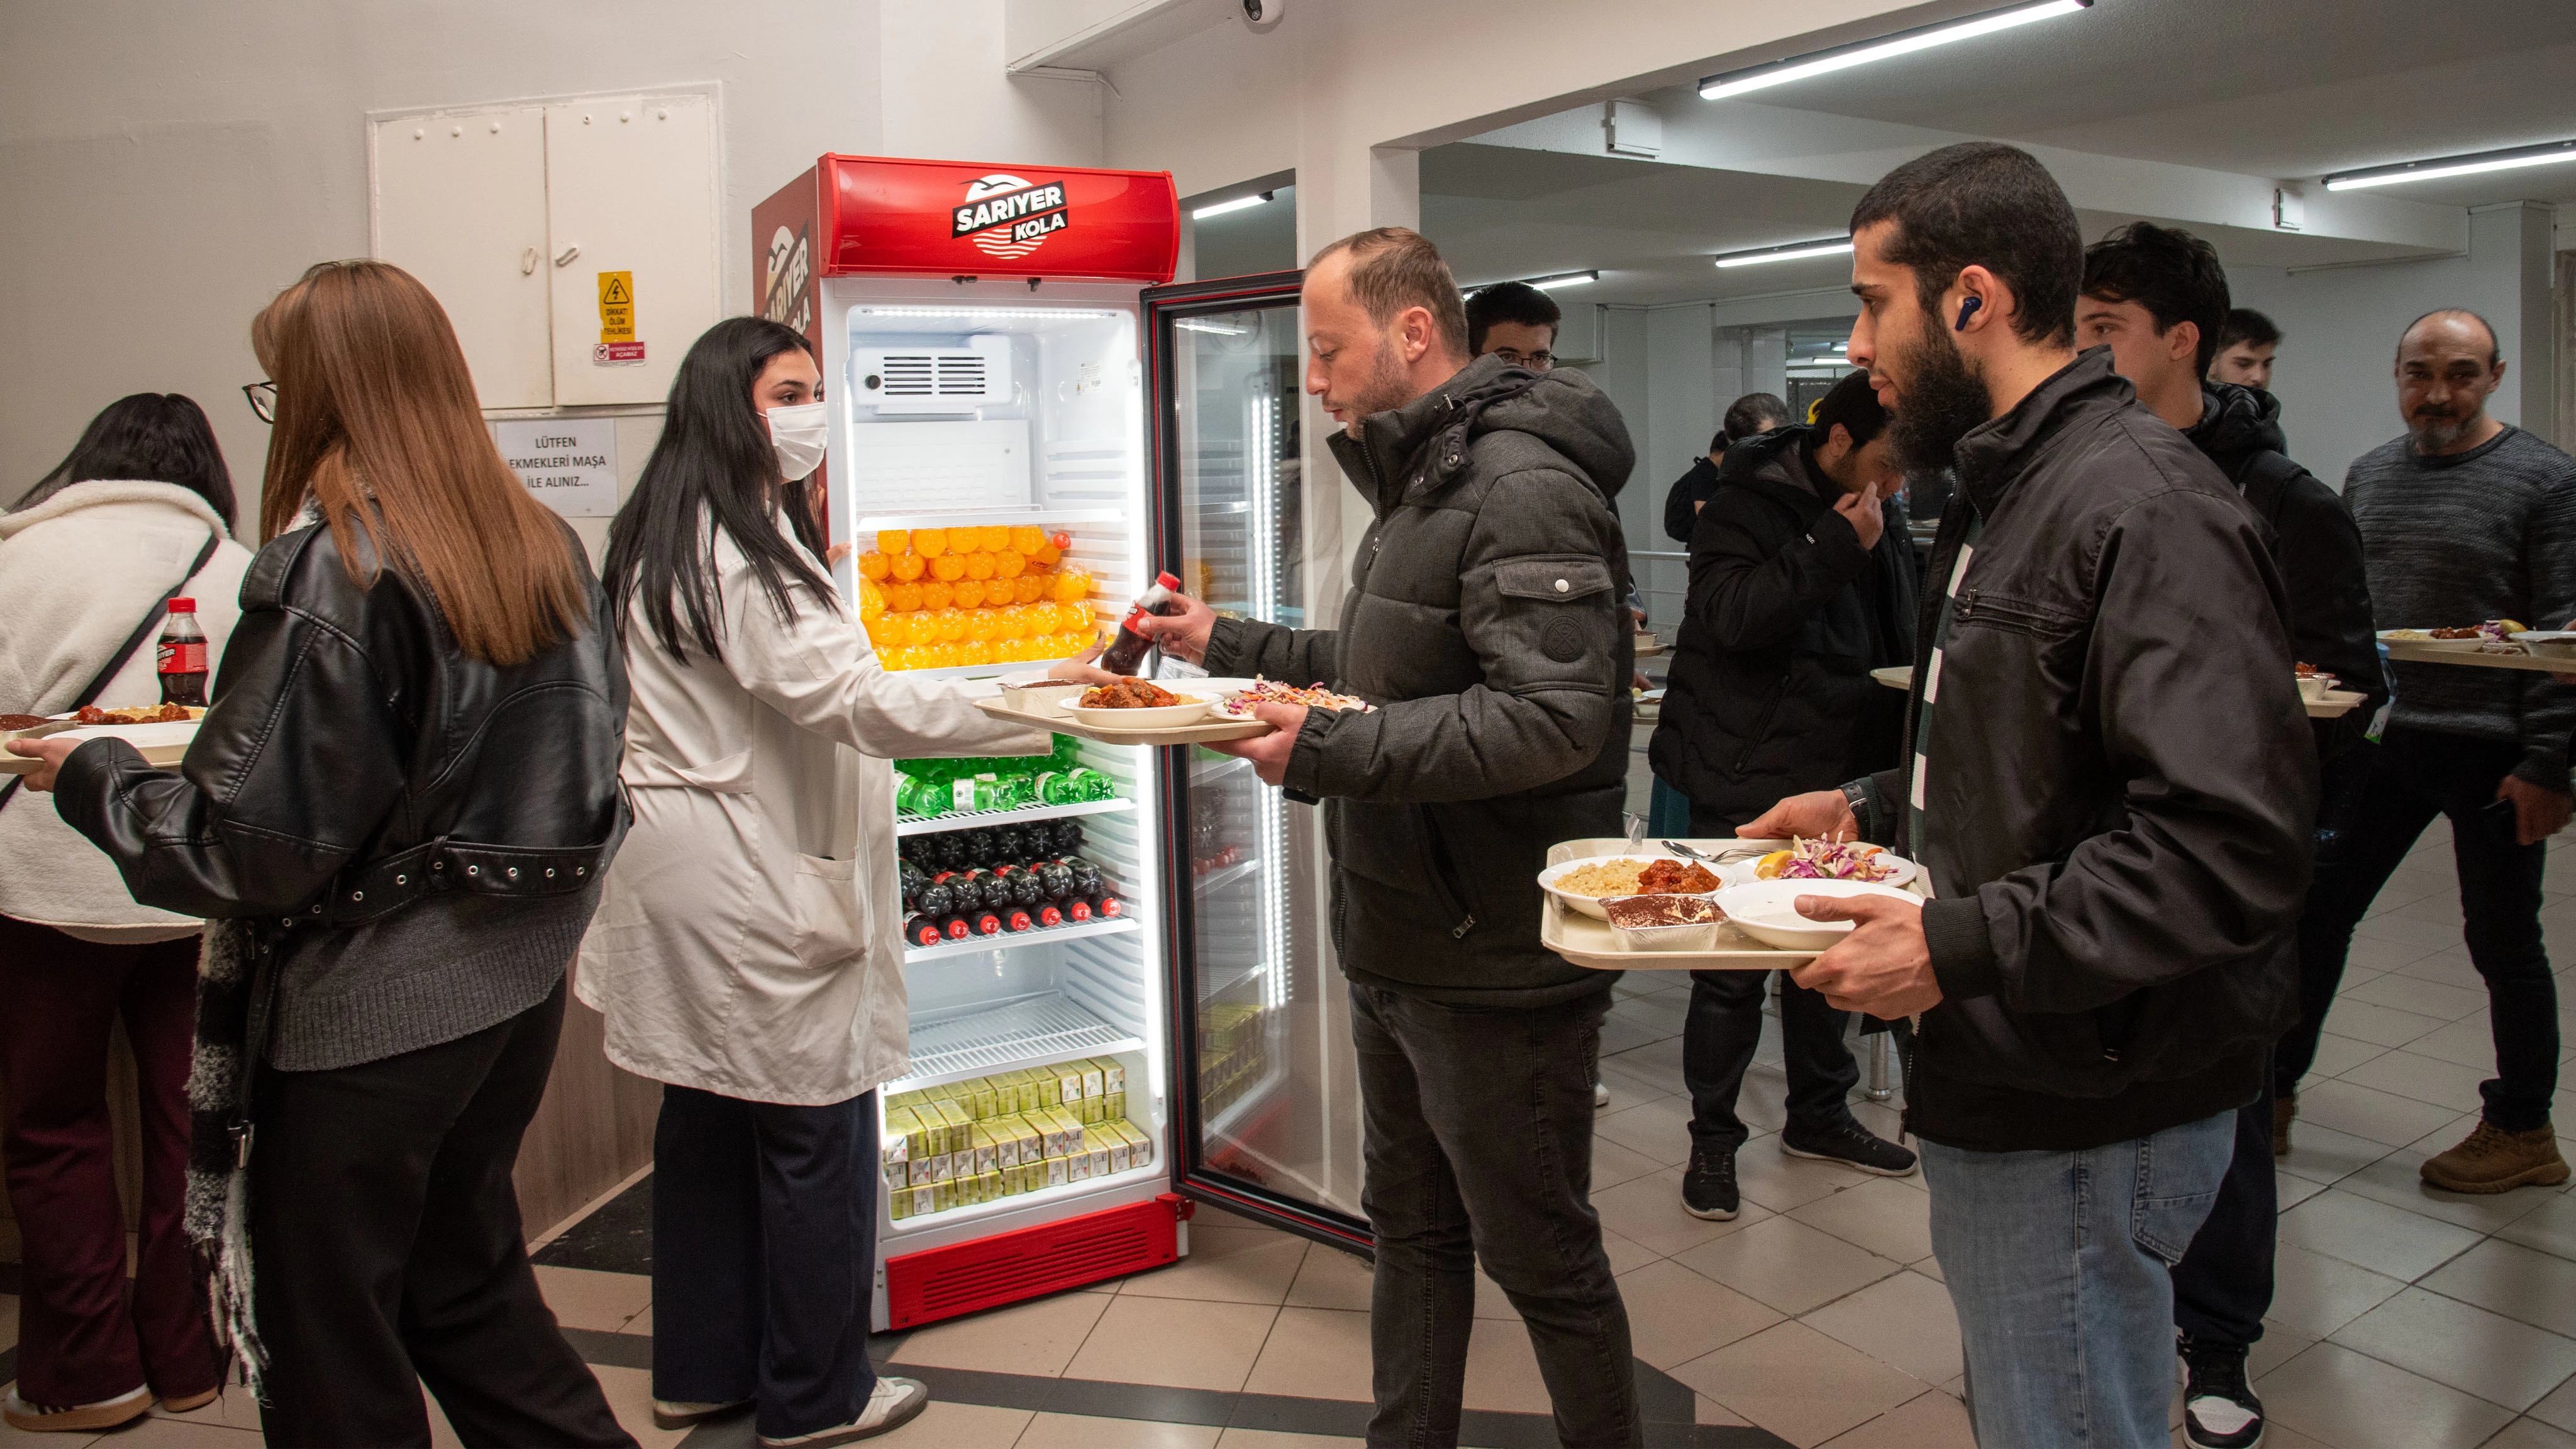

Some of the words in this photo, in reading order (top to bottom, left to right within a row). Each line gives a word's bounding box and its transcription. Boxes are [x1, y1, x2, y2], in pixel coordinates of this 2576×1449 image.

[957, 186, 1063, 231] SARIYER
[1015, 213, 1066, 241] KOLA
[791, 296, 811, 335] OLA
[535, 436, 577, 448] LÜTFEN
[509, 455, 569, 469] EKMEKLERİ
[573, 456, 606, 469] MAŞA
[527, 475, 542, 488] İLE
[545, 476, 589, 487] ALINIZ...
[158, 648, 175, 660] RIYER
